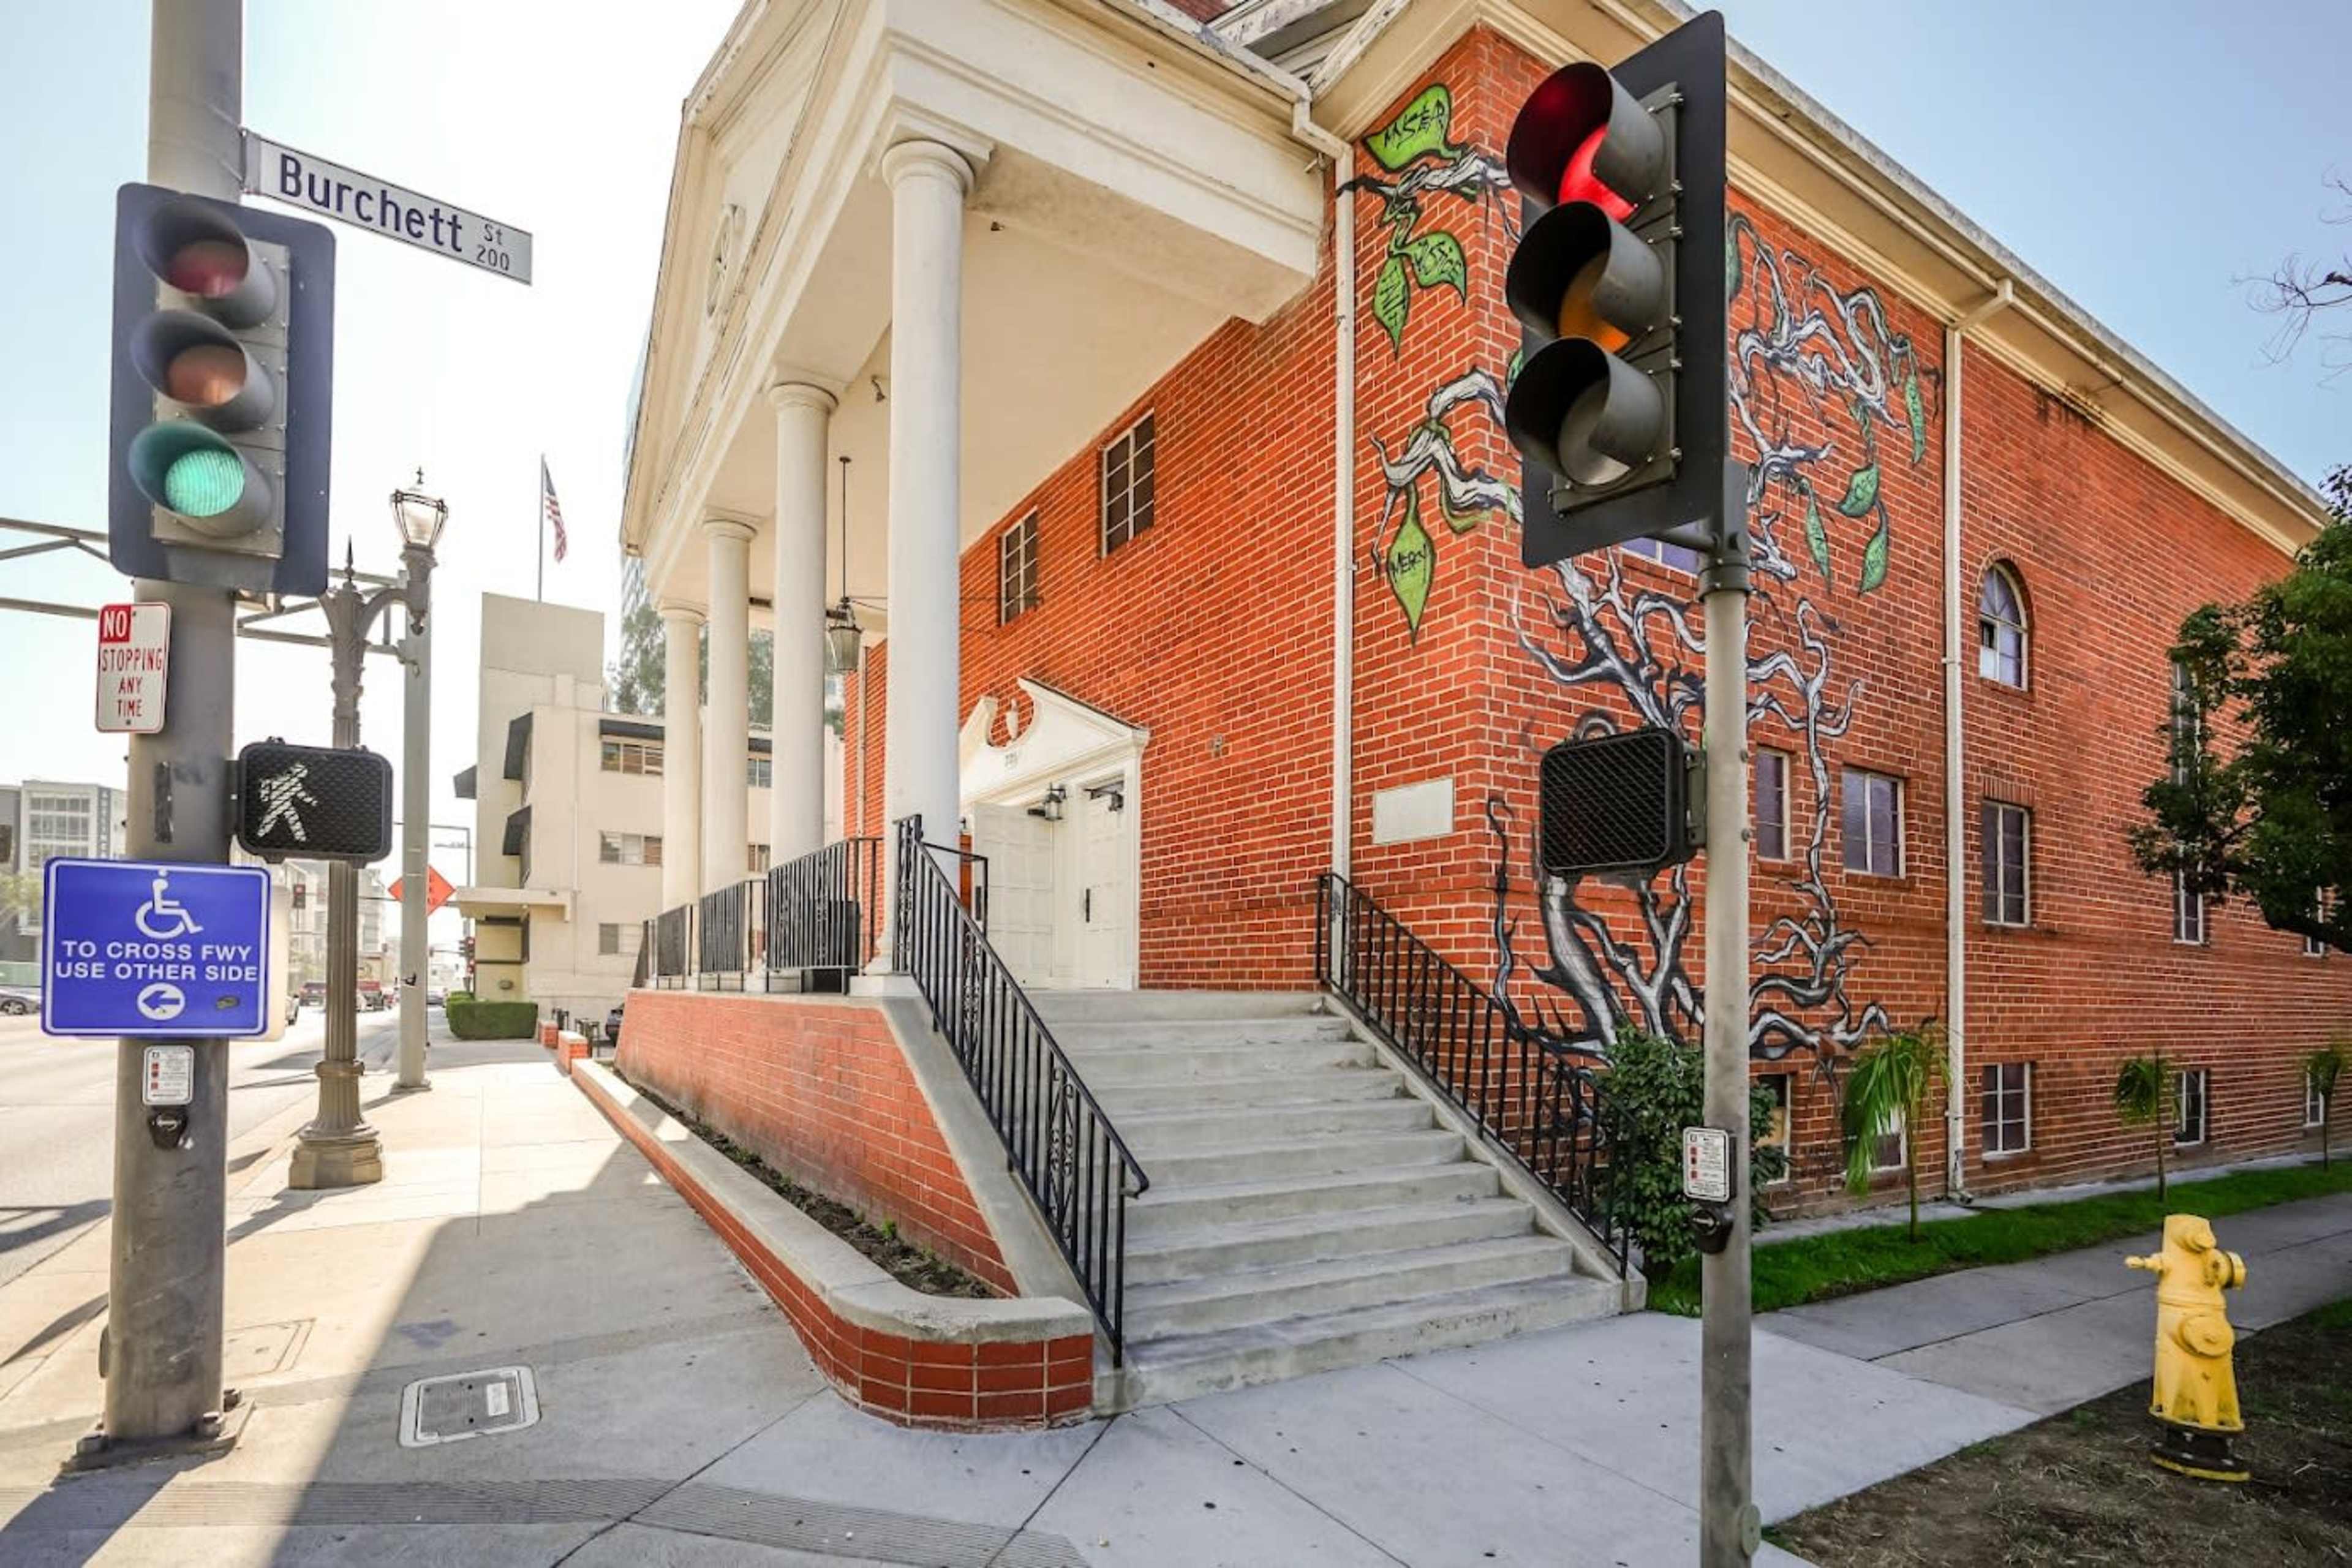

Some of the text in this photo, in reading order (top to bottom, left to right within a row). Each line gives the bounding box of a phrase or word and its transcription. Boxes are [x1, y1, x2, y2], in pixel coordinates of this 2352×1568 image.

[280, 153, 503, 252] Burchett St
[476, 248, 510, 271] 200
[104, 610, 128, 638] NO
[102, 648, 162, 672] STOPPING
[118, 676, 143, 695] ANY
[117, 699, 142, 717] TIME
[62, 941, 252, 962] TO CROSS FWY
[56, 962, 257, 982] USE OTHER SIDE
